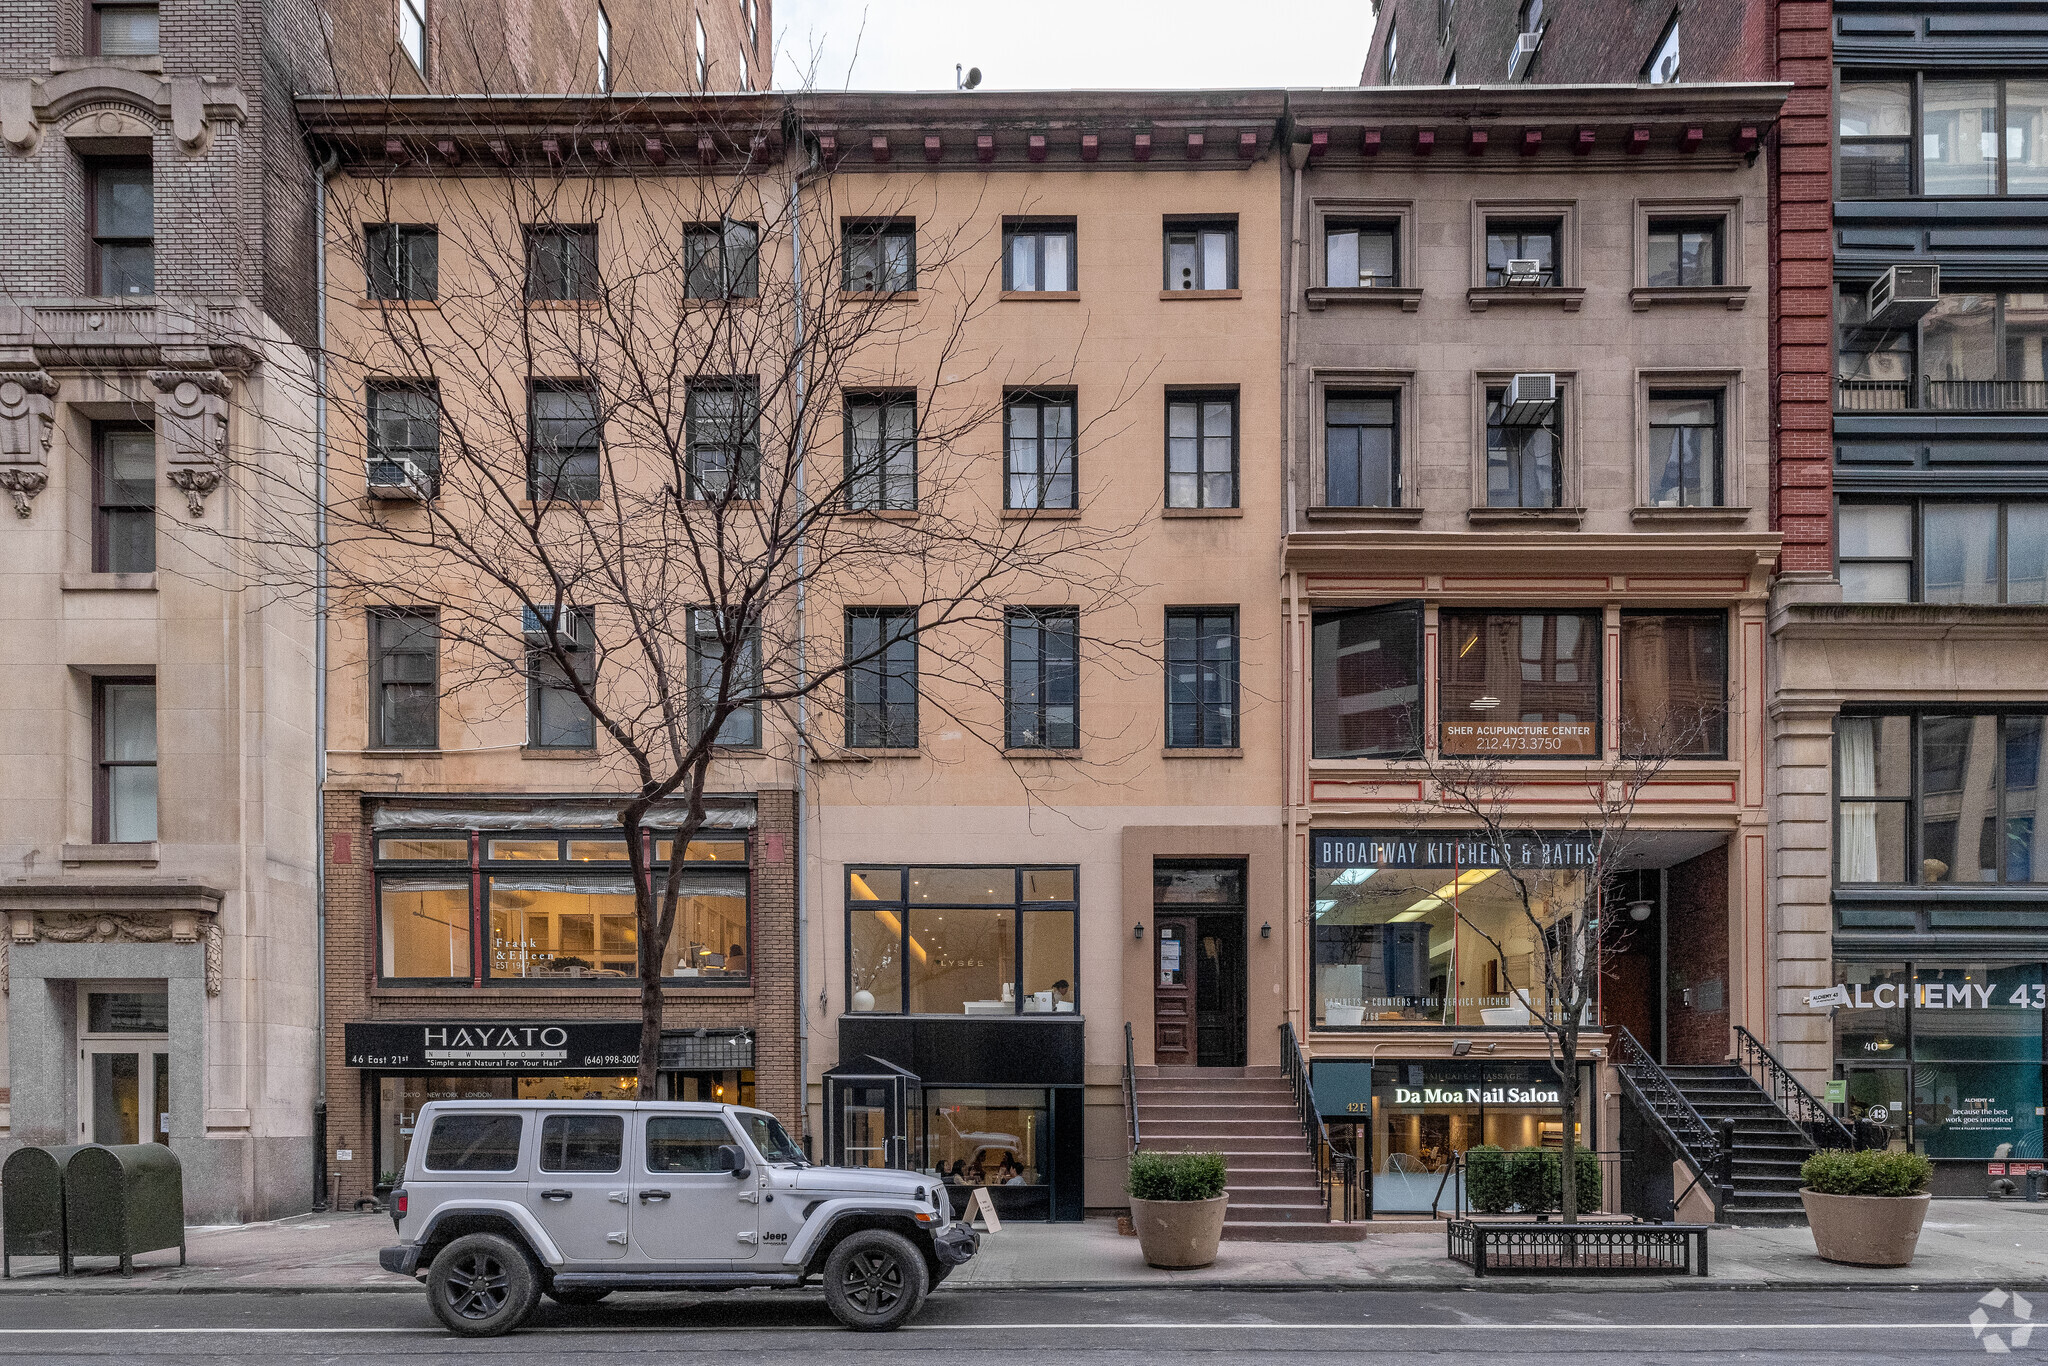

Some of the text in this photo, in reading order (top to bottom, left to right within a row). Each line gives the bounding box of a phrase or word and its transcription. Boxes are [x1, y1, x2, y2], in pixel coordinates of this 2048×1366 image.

[1448, 726, 1590, 735] SHER ACUPUNCTURE CENTER
[1476, 737, 1562, 750] 212.473.3750
[1323, 842, 1595, 865] BROADWAY KITCHENS & BATHS
[496, 938, 536, 948] Frank
[496, 962, 530, 970] EST 197
[2008, 983, 2046, 1009] 43
[1372, 997, 1411, 1007] COUNTERS
[1421, 997, 1439, 1007] FULL
[1443, 997, 1474, 1007] SERVICE
[425, 1027, 568, 1047] HAYATO
[1864, 1042, 1879, 1051] 40
[428, 1050, 563, 1058] NEW YORK
[352, 1055, 409, 1064] 46 East 21st
[584, 1055, 604, 1066] (646)
[1395, 1087, 1560, 1104] Da Moa Nail Salon
[1871, 1109, 1886, 1119] 43
[762, 1231, 788, 1241] Jeep
